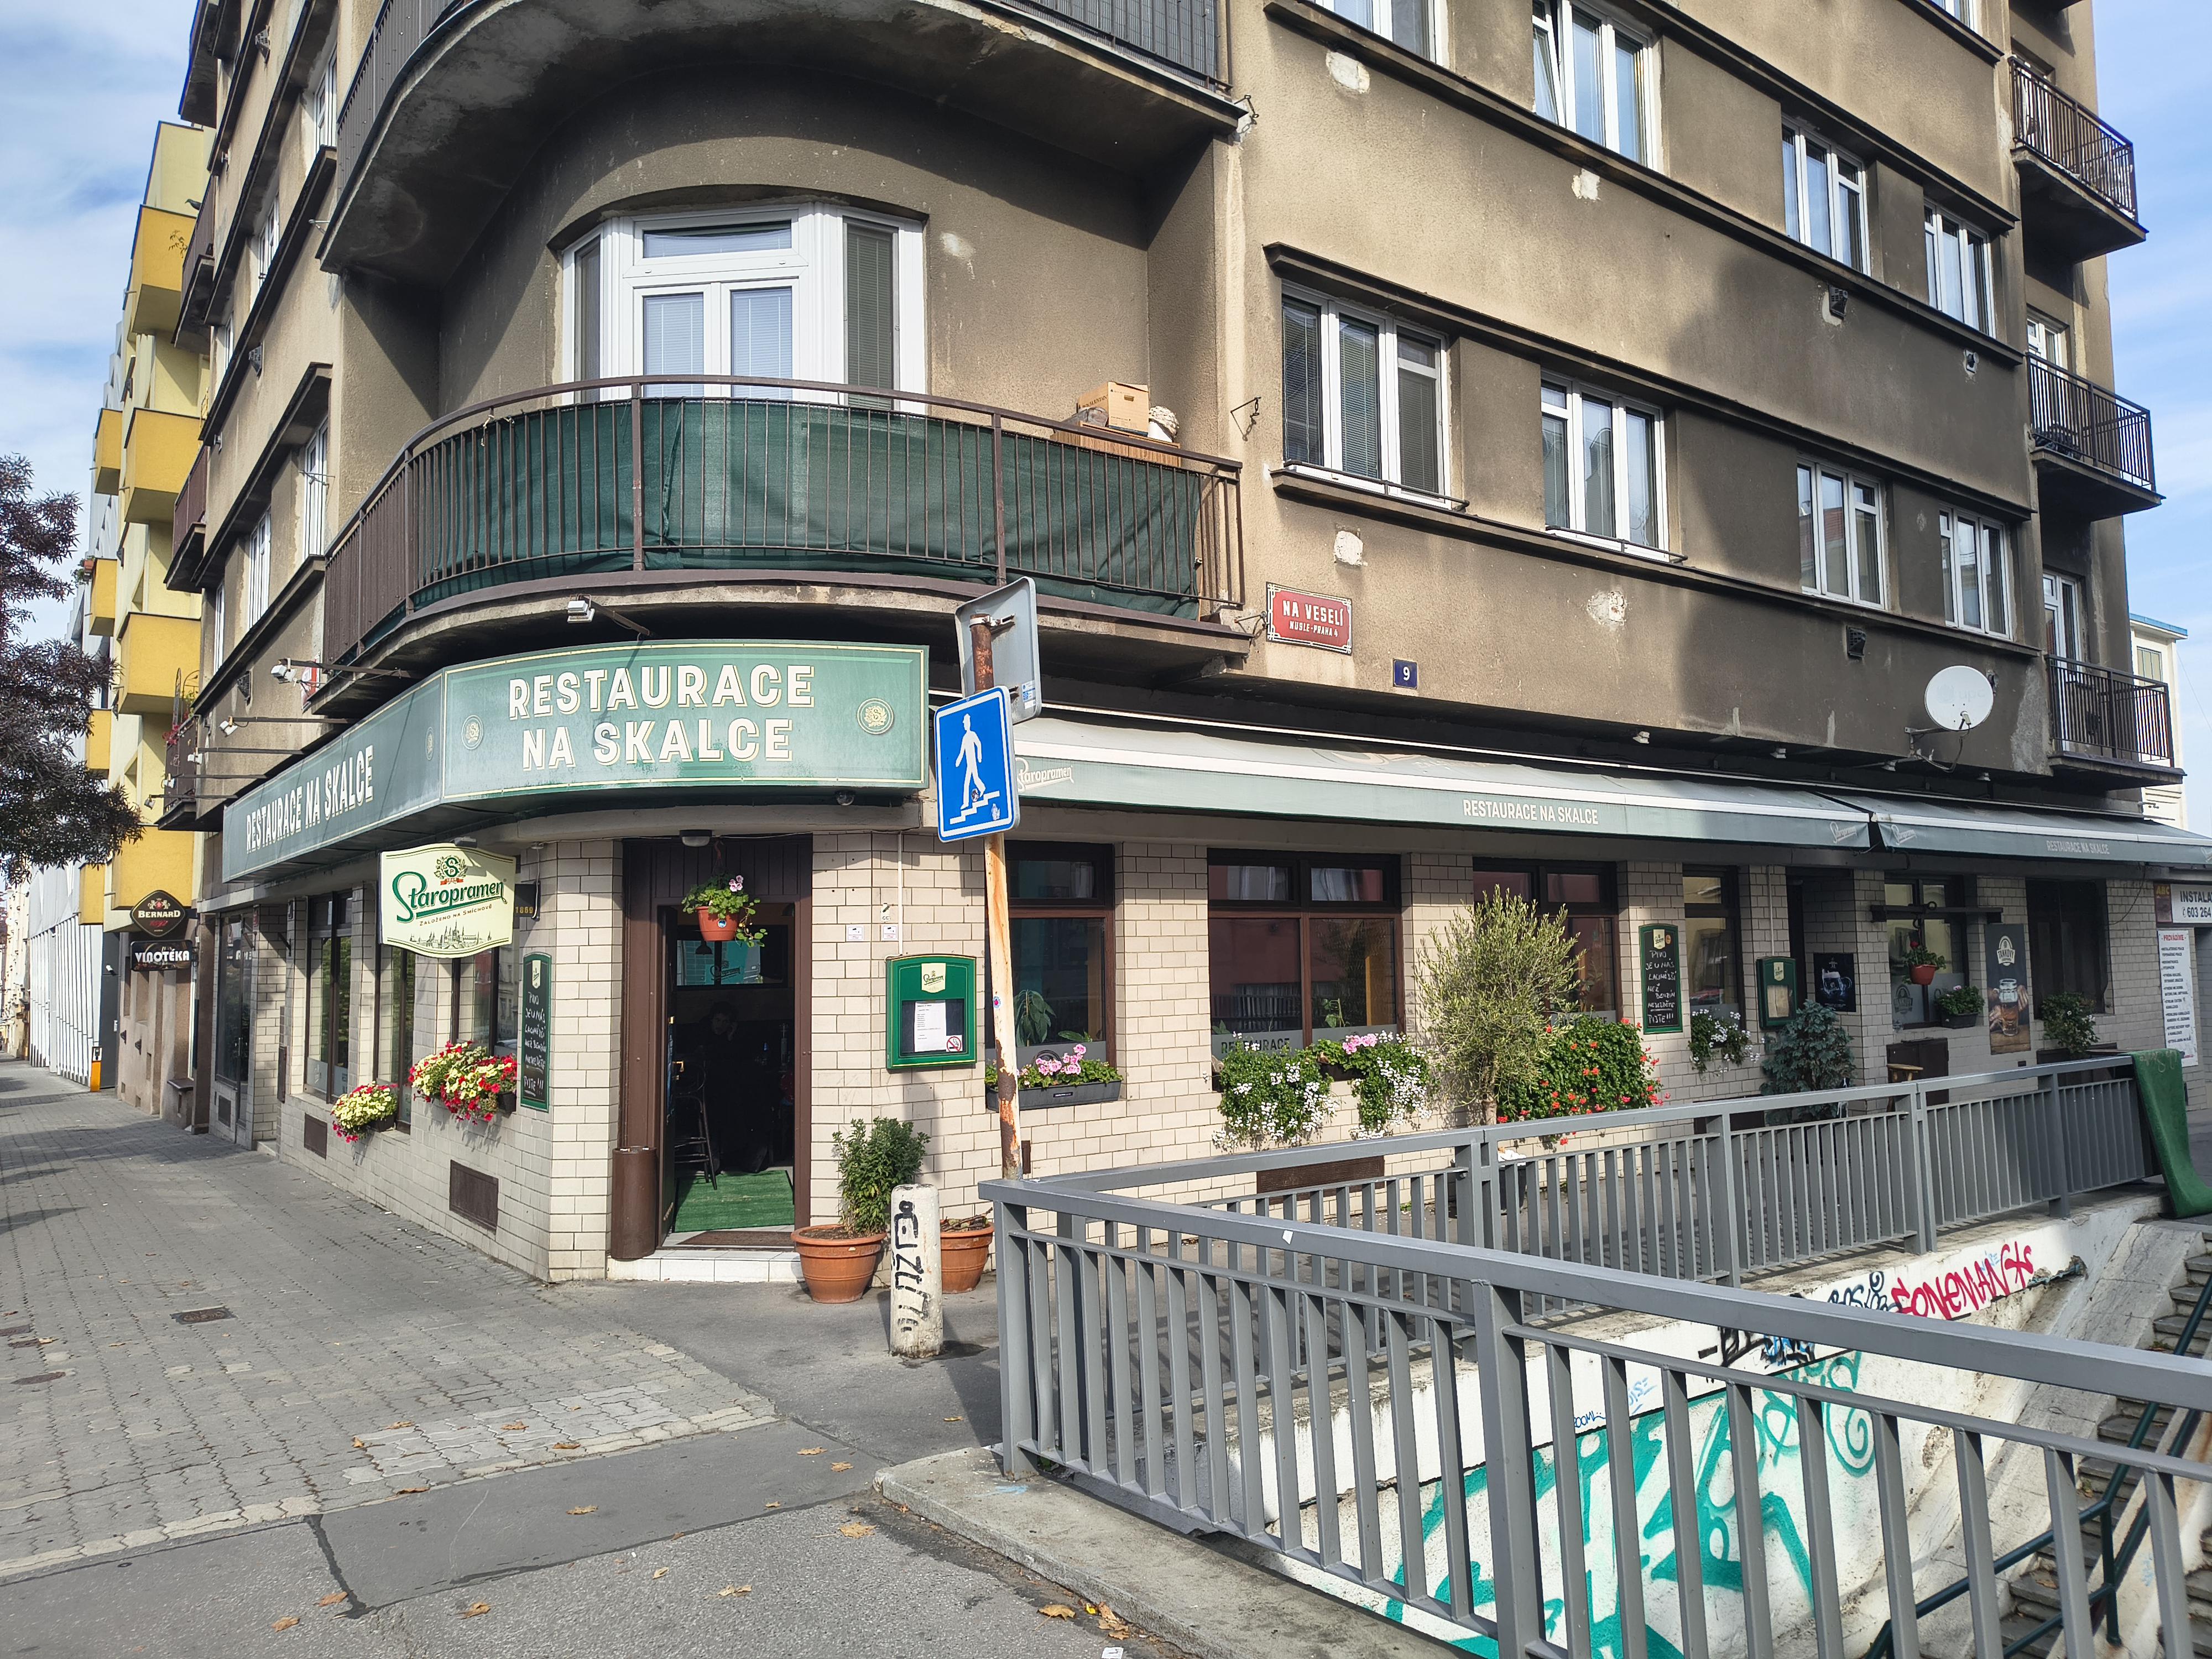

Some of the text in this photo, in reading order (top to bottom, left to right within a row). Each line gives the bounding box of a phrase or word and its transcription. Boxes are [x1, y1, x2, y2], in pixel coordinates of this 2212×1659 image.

[1282, 599, 1344, 627] NA VESELÍ
[1334, 629, 1338, 638] 4
[1402, 666, 1410, 681] 9
[509, 664, 815, 721] RESTAURACE
[522, 717, 794, 772] NA SKALCE
[246, 744, 374, 854] RESTAURACE NA SKALCE
[1463, 799, 1599, 825] RESTAURACE NA SKALCE
[2047, 840, 2110, 854] RESTAURACE NA SKALCE
[392, 870, 508, 924] Staropramen
[2180, 890, 2212, 902] INSTALA
[138, 910, 181, 918] BERNARD
[420, 915, 451, 926] ZALOŽENO
[463, 904, 492, 916] SMÍCHOVĚ
[2187, 907, 2211, 917] 603 264
[135, 948, 190, 963] VINOTÉKA
[1649, 950, 1667, 958] PIVO
[1645, 962, 1653, 971] JE
[1647, 983, 1660, 993] NEŽ
[1655, 989, 1675, 999] BENZÍN
[528, 992, 539, 1005] PIVO
